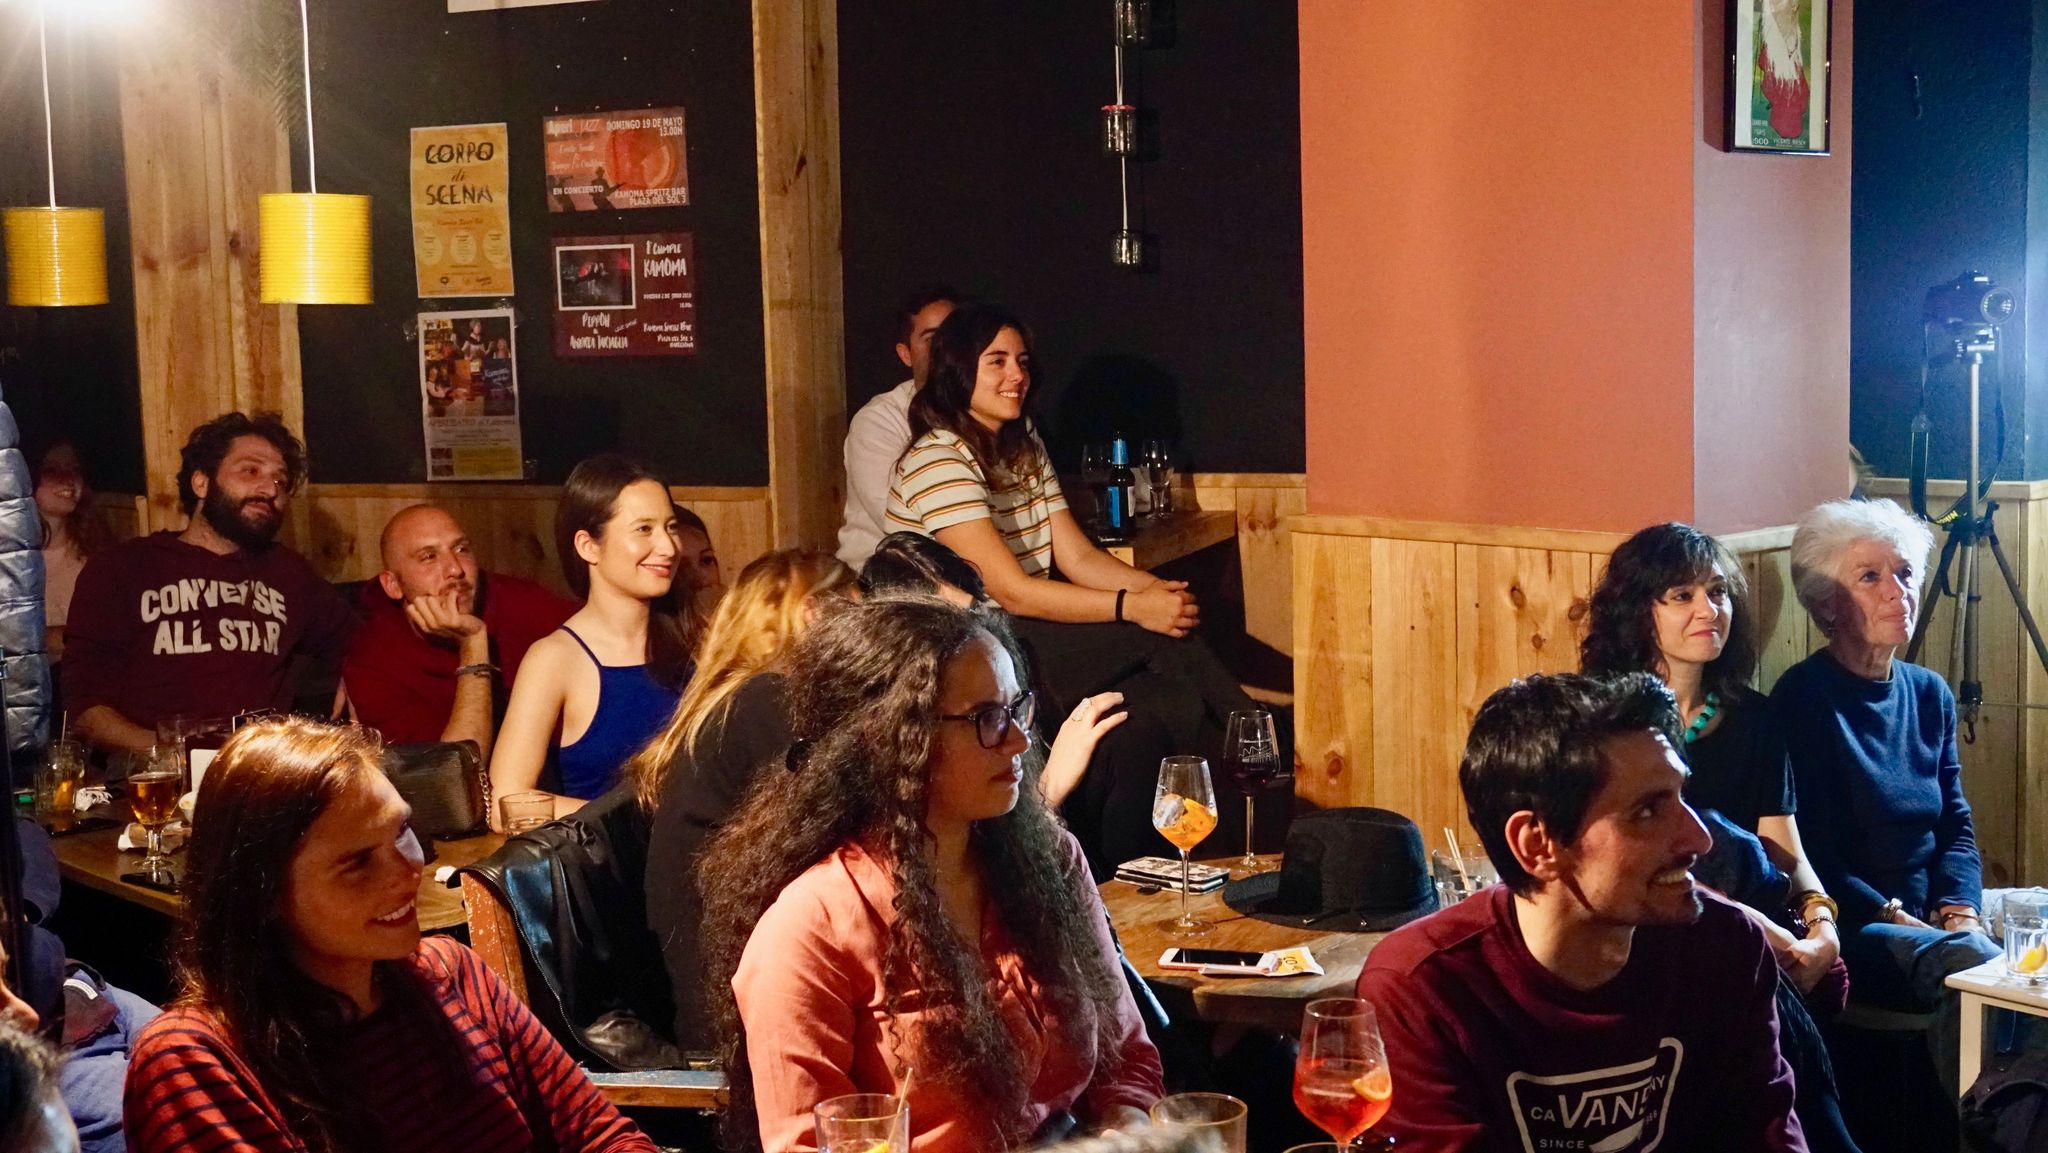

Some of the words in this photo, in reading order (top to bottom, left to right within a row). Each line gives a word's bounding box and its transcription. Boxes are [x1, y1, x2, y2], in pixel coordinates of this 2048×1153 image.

[606, 119, 640, 131] DOMINGO
[642, 118, 651, 129] 19
[652, 118, 661, 128] DE
[662, 116, 683, 127] MAYO
[425, 141, 494, 164] CORPO
[451, 168, 466, 182] di
[425, 184, 494, 206] SCENA
[552, 187, 563, 195] EN
[563, 185, 604, 195] CONCIERTO
[643, 257, 687, 278] KAMOMA
[153, 618, 212, 656] ALL
[218, 617, 281, 656] STAR
[1530, 1106, 1556, 1122] CA
[1539, 1138, 1585, 1150] SINCE
